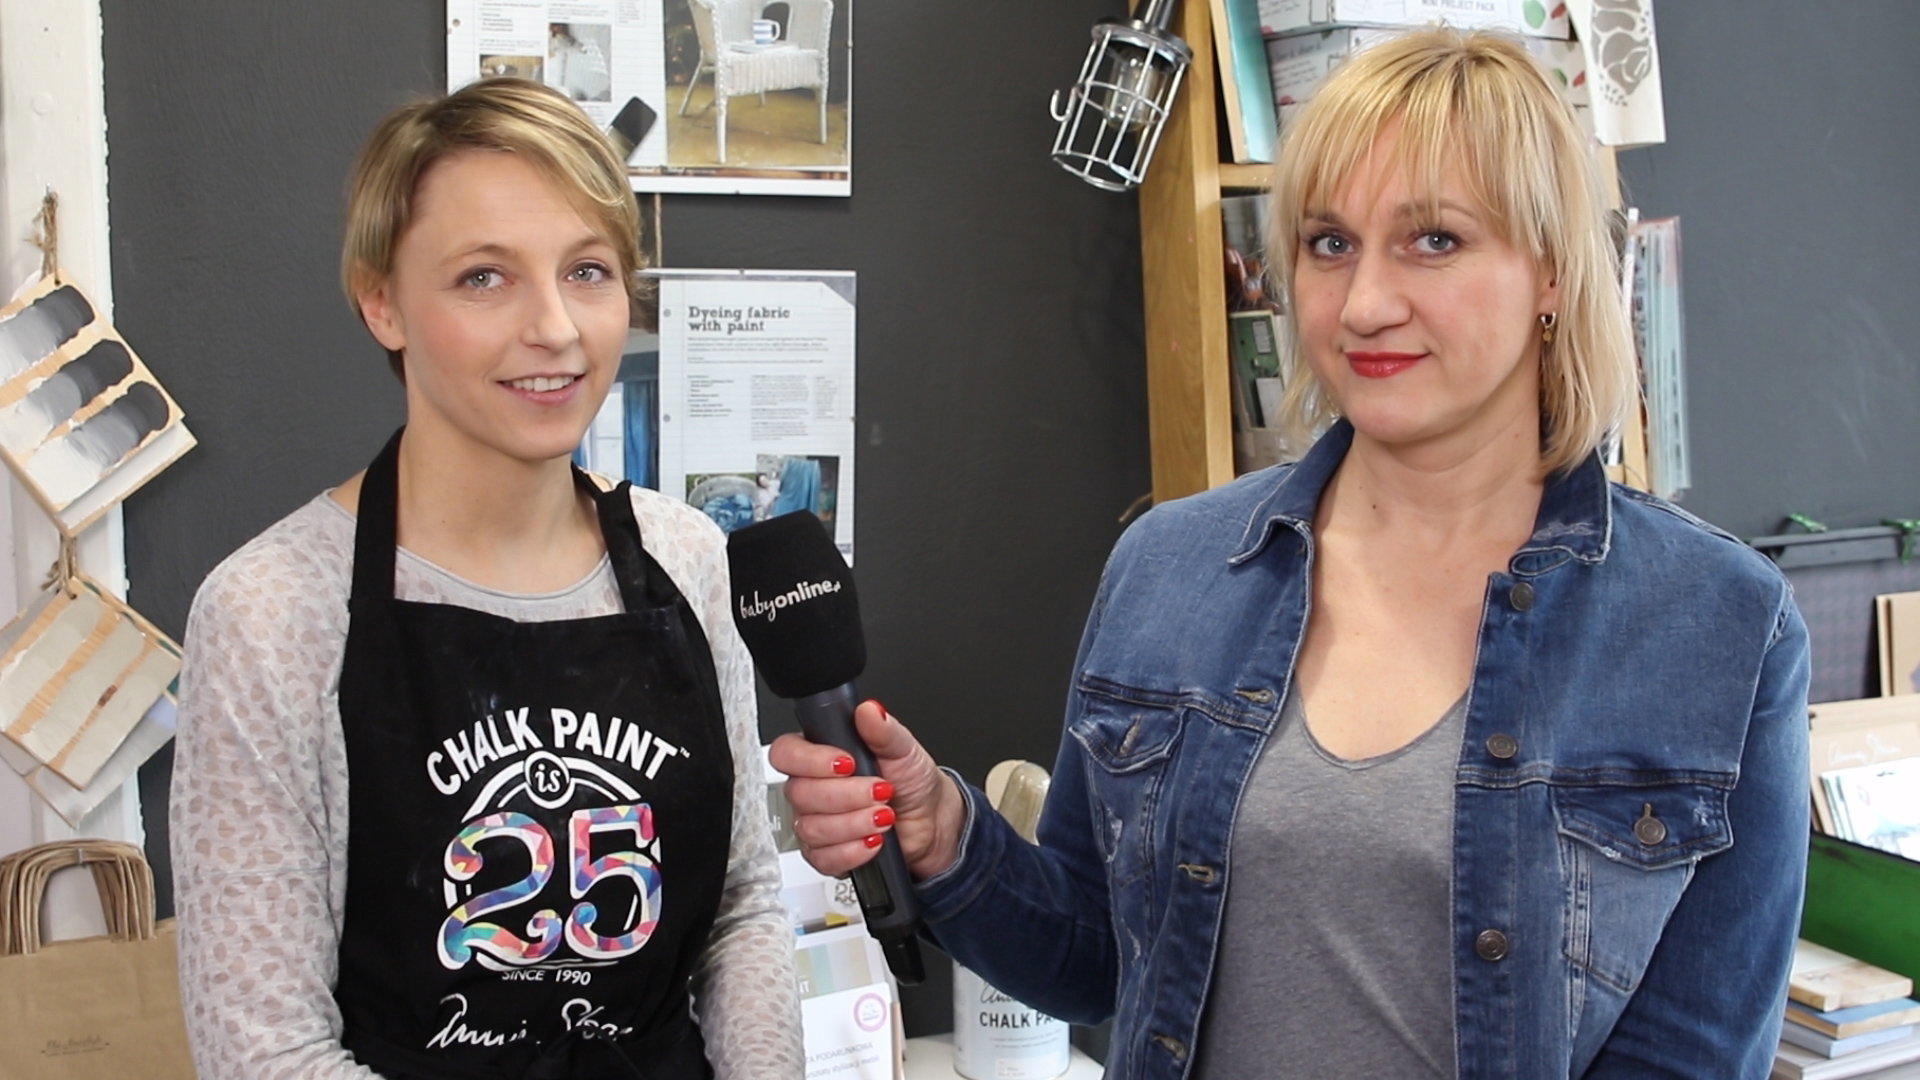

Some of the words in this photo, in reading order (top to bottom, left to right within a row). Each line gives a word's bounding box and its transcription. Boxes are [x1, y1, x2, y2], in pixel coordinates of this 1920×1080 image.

[1475, 1, 1496, 11] PACK
[688, 306, 742, 322] Dyeing
[747, 306, 791, 319] fabric
[688, 320, 722, 332] with
[727, 321, 764, 335] paint
[426, 707, 543, 795] CHALK
[534, 763, 561, 793] is
[437, 803, 662, 970] 25
[502, 968, 545, 982] SINCE
[555, 969, 591, 985] 1990
[979, 1011, 1031, 1029] CHALK
